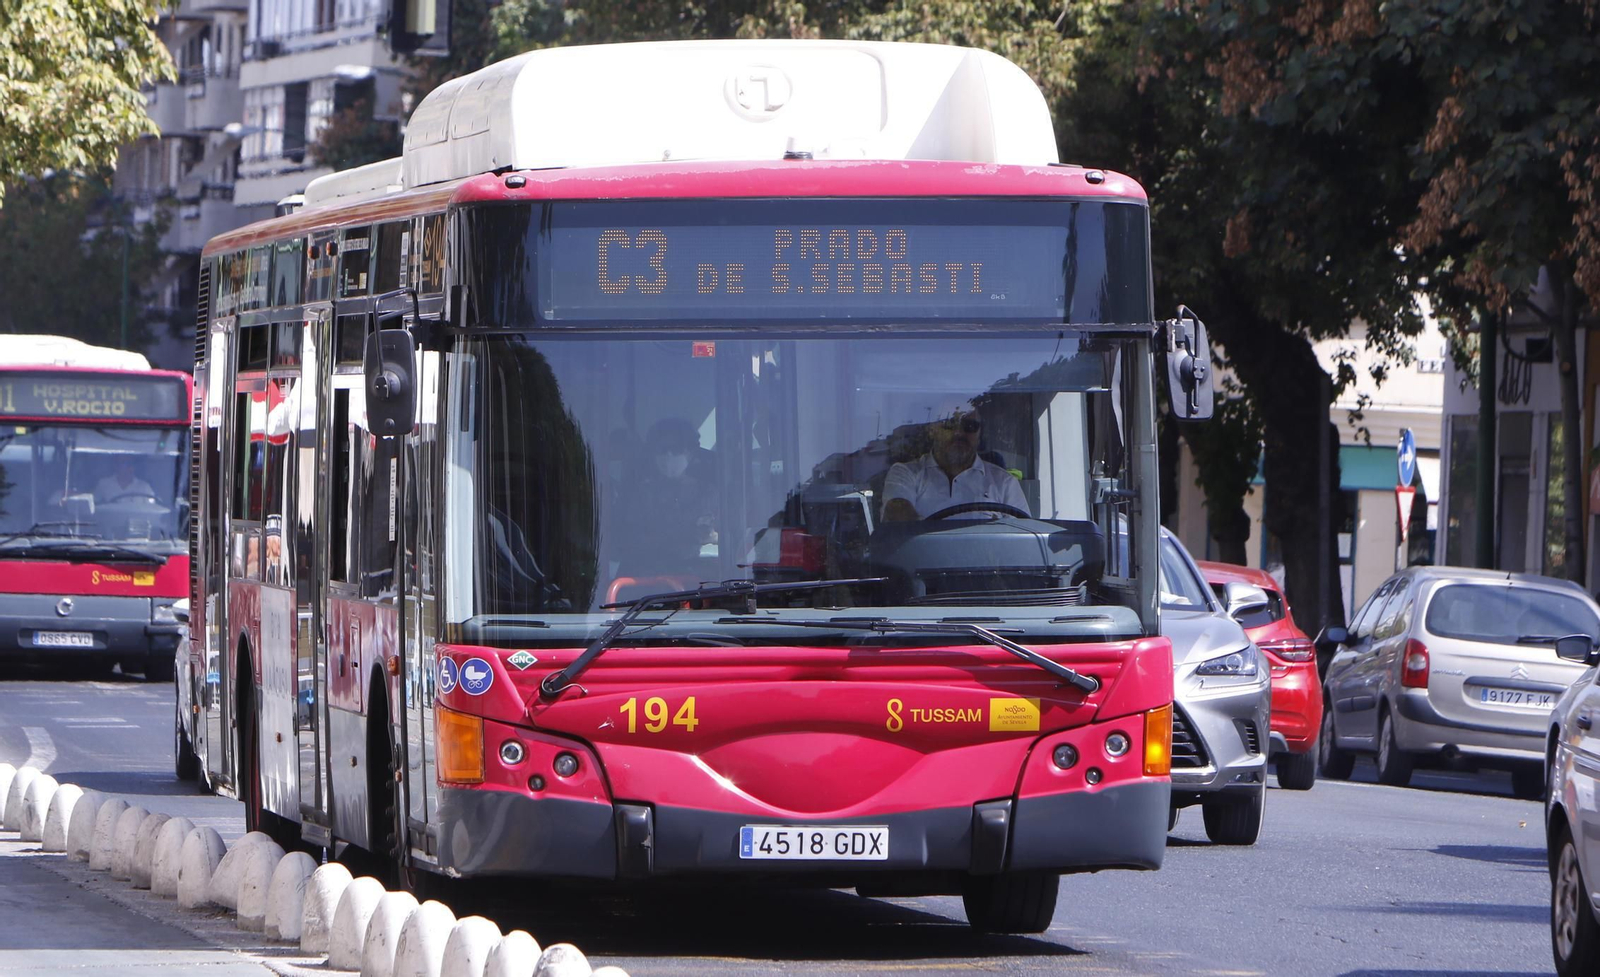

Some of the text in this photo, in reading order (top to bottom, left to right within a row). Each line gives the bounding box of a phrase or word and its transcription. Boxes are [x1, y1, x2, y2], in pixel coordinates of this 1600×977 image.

[774, 228, 907, 260] PRADO
[598, 229, 668, 295] C3
[697, 262, 984, 294] DE S.SEBASTI
[33, 383, 137, 400] HOSPITAL
[44, 401, 126, 415] V.ROCIO
[511, 655, 531, 664] GNC
[1489, 690, 1522, 704] 9177
[619, 696, 700, 734] 194
[910, 708, 982, 723] TUSSAM
[759, 832, 882, 855] 4518 GDX
